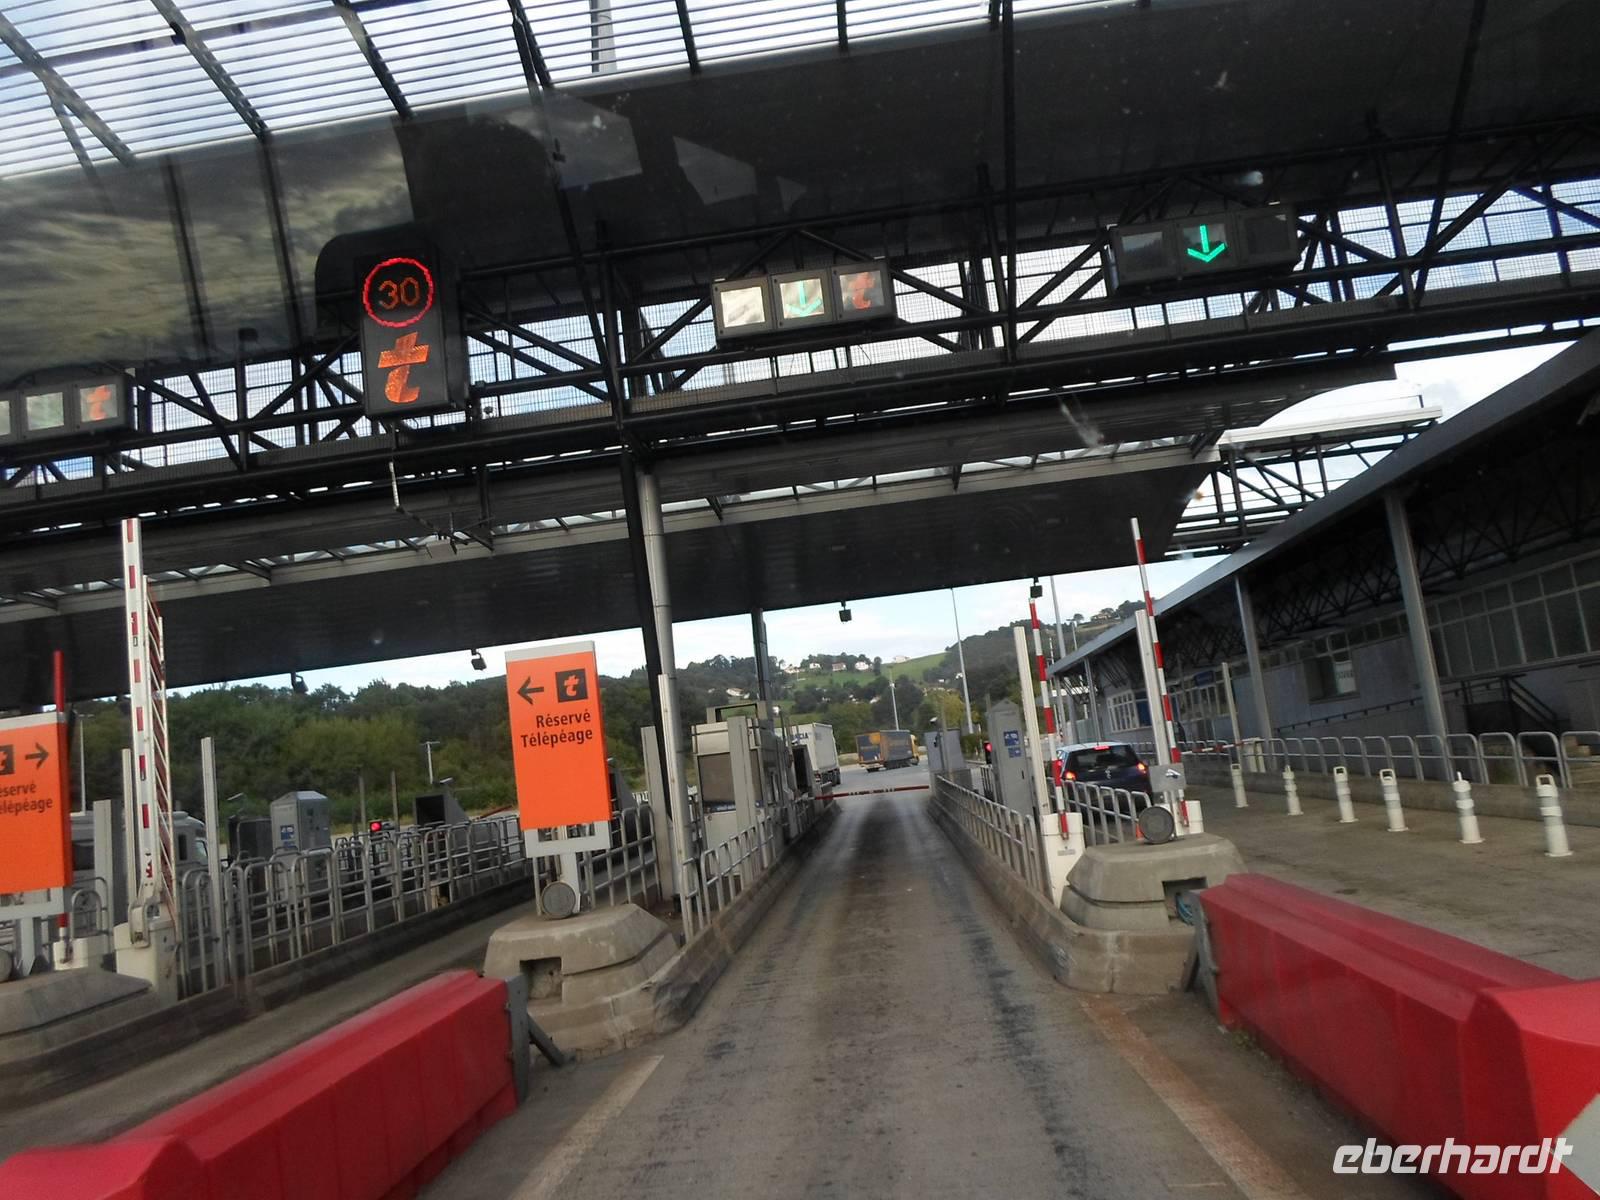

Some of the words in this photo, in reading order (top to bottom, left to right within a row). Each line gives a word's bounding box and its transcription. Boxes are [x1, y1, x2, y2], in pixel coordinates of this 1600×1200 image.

[377, 276, 421, 311] 30
[535, 709, 592, 729] Réservé
[520, 729, 594, 749] Télépéage
